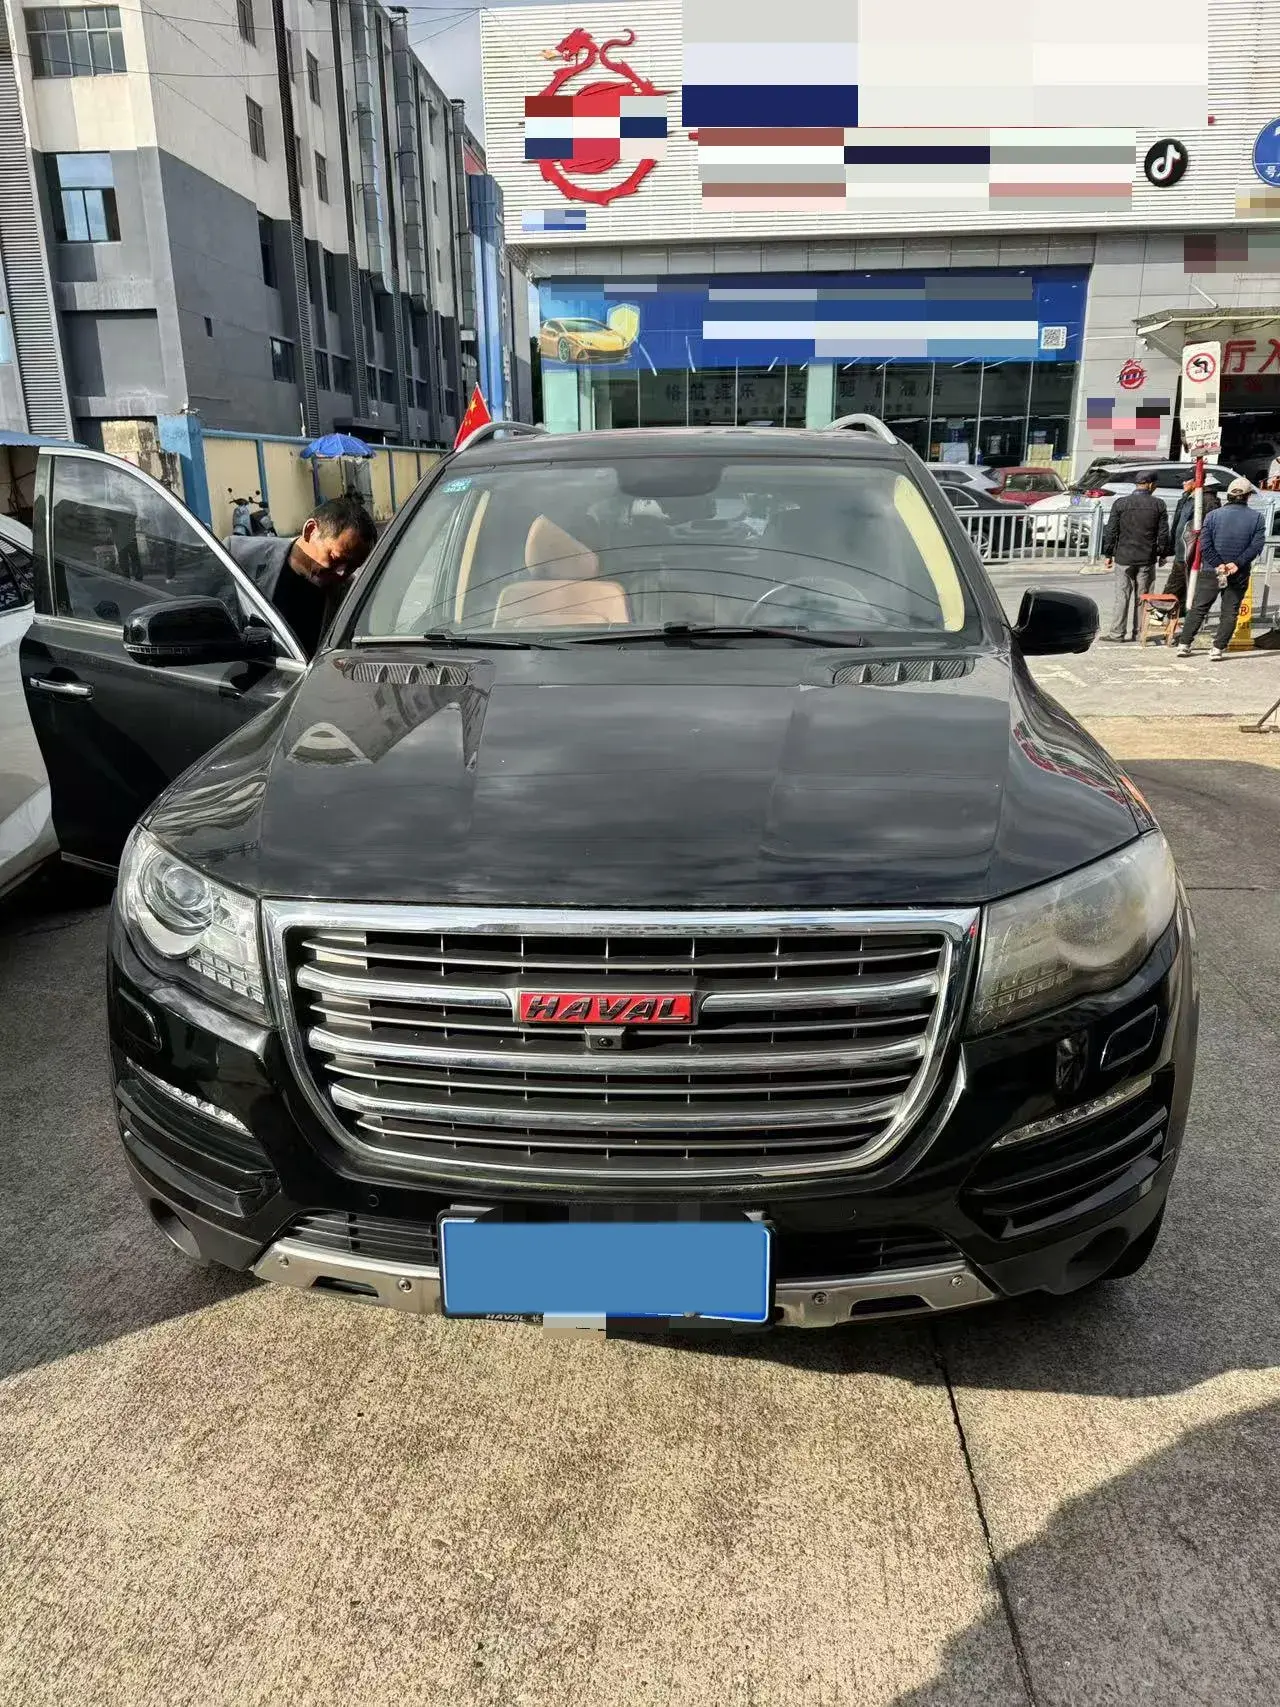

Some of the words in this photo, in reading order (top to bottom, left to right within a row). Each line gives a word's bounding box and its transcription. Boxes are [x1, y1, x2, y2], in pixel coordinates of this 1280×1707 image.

[1184, 339, 1280, 373] 厅入
[525, 995, 689, 1021] HAVAL
[486, 1313, 526, 1322] HAVAL
